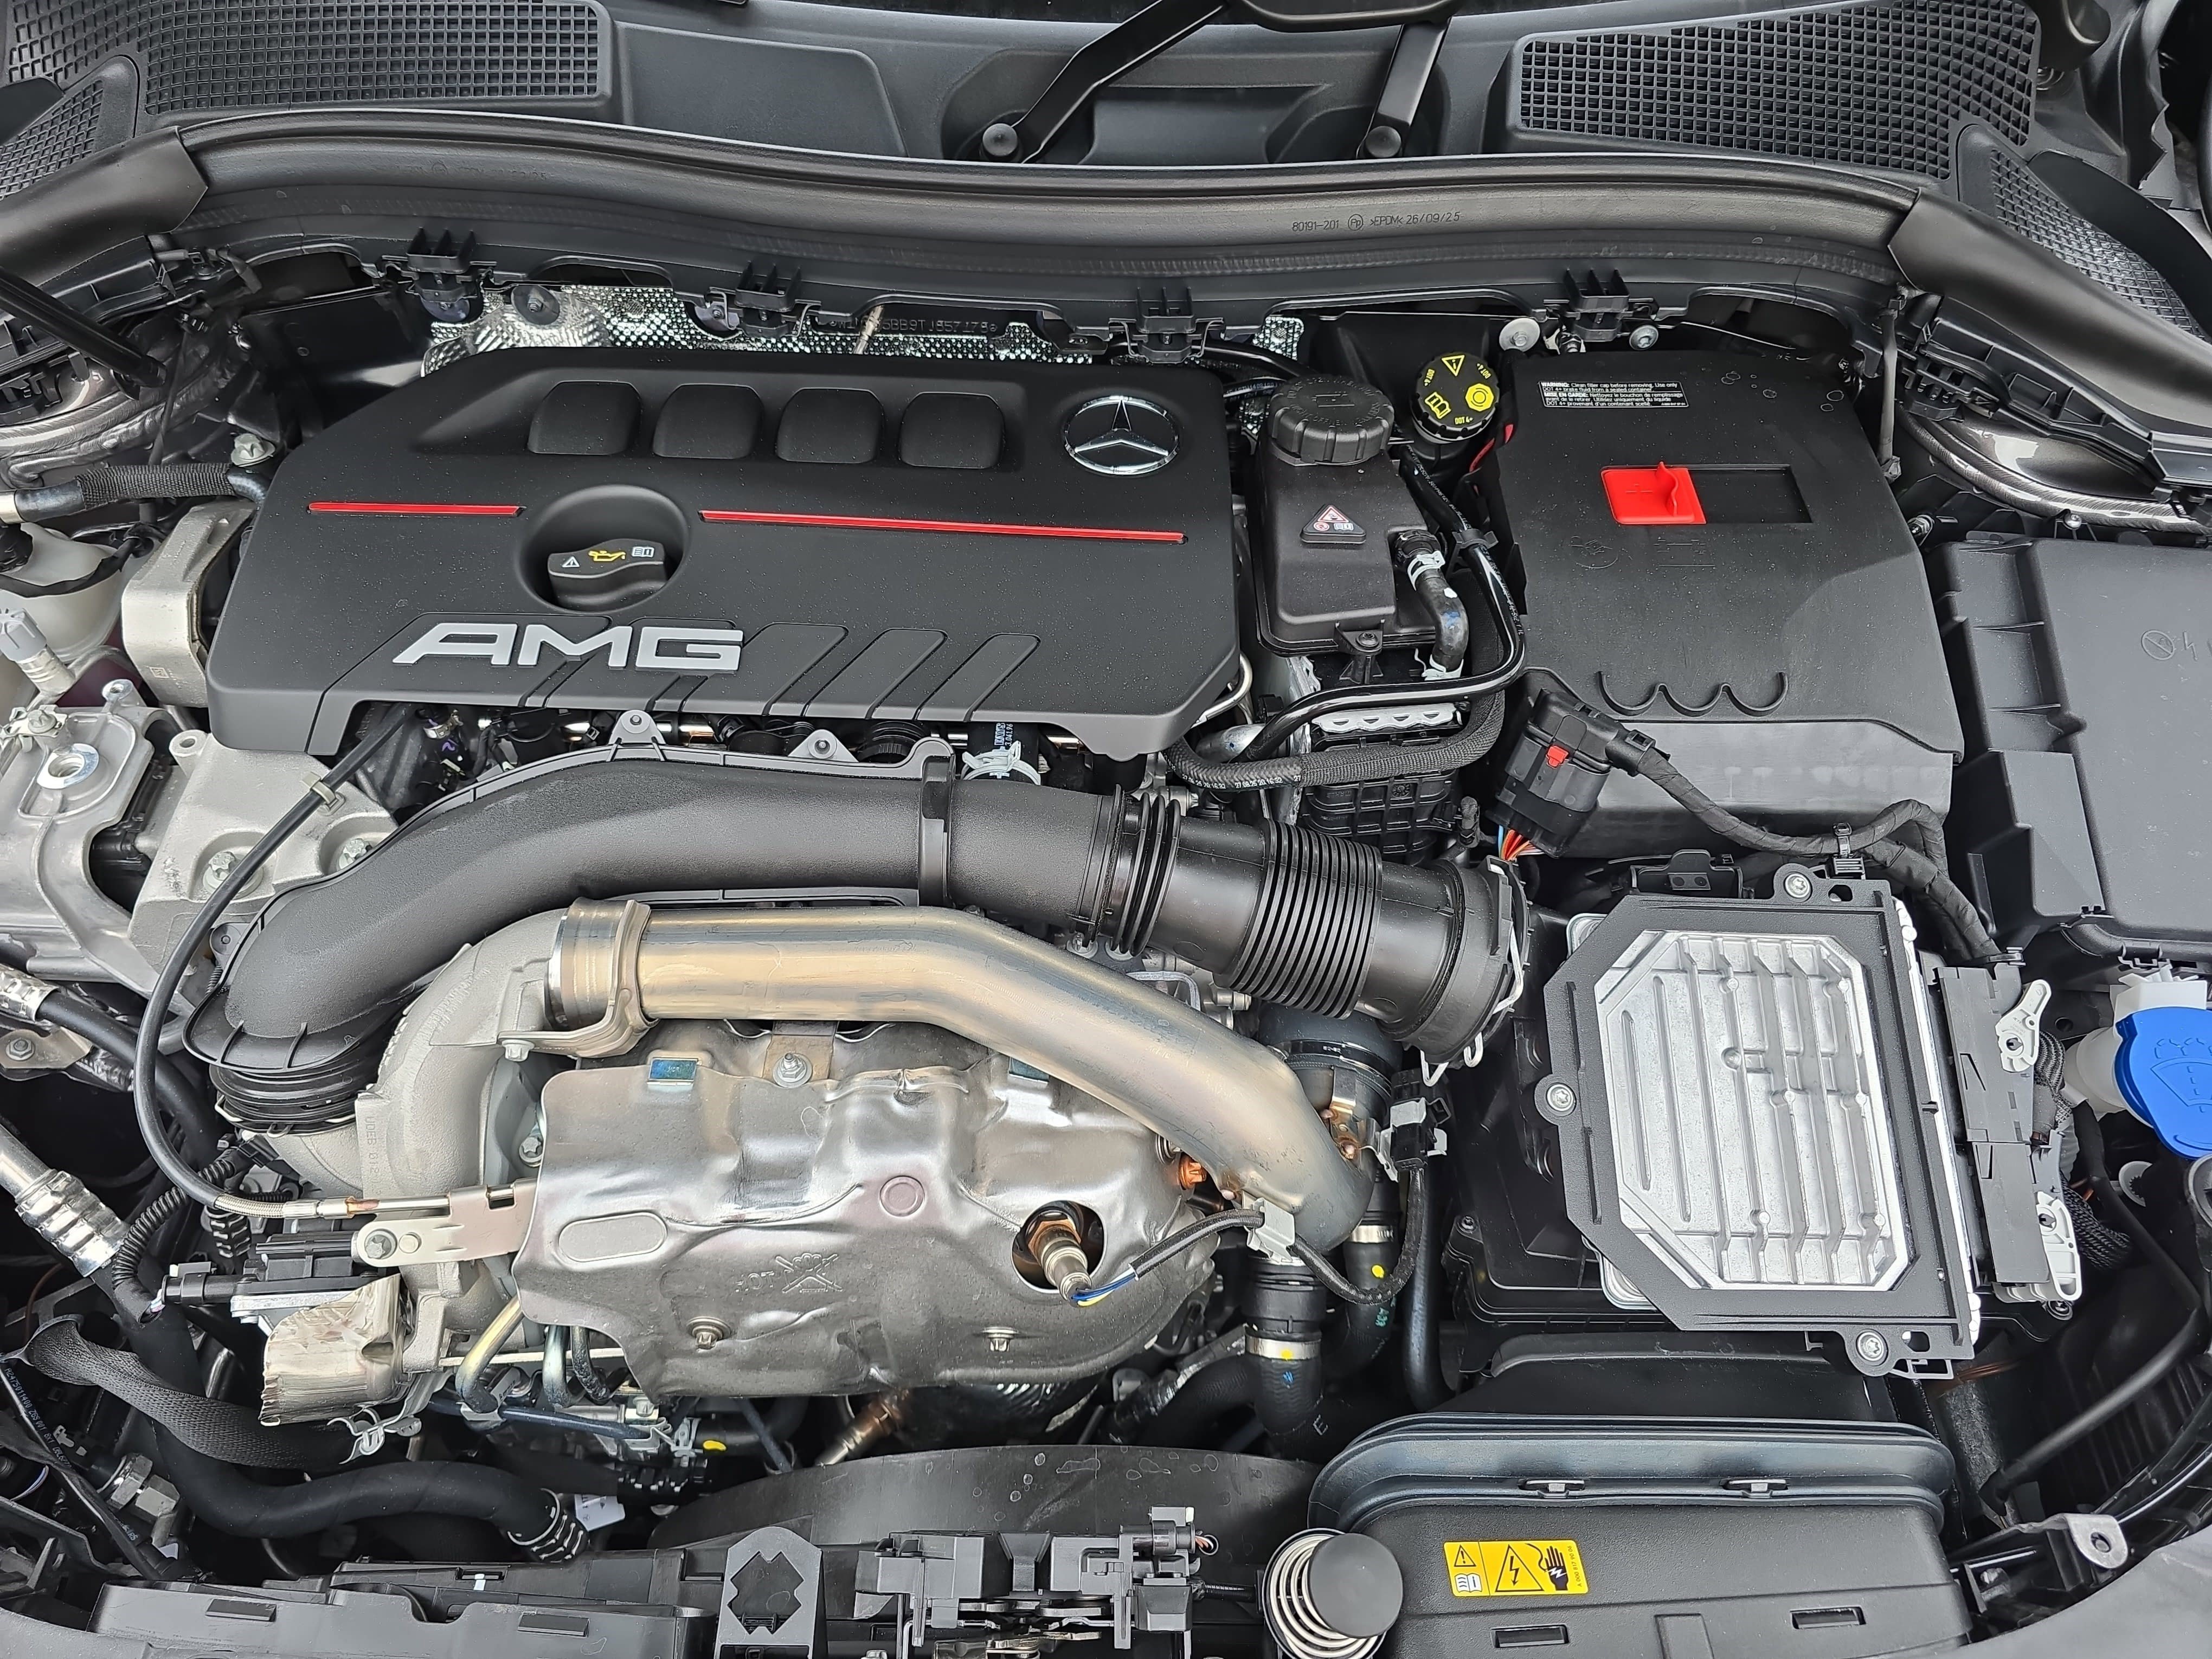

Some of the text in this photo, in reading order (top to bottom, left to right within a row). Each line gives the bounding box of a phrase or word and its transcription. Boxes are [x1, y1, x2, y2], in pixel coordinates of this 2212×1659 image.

[1291, 220, 1339, 232] 80191-201
[1406, 211, 1460, 225] 26/09/25
[1427, 369, 1435, 380] DOT
[1480, 369, 1491, 379] DOT
[1455, 416, 1465, 425] DOT
[392, 623, 744, 671] AMG
